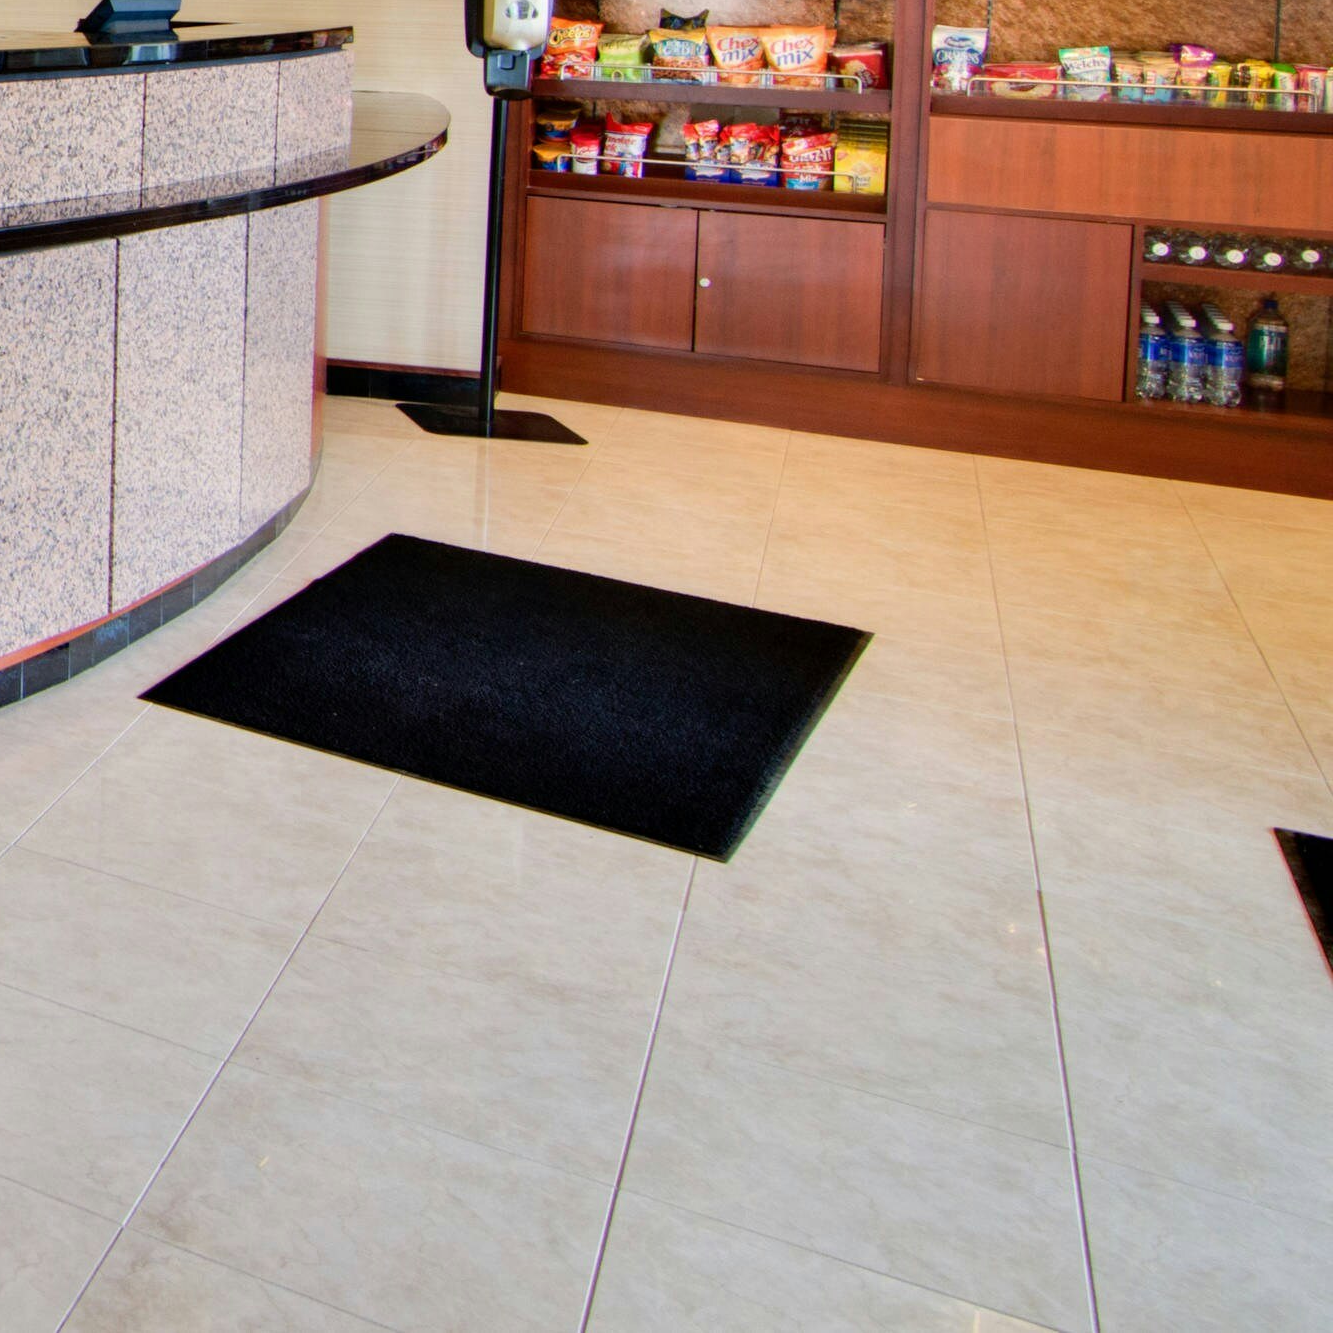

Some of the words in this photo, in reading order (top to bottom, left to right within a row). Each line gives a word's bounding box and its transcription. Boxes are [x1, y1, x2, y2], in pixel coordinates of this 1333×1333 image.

[549, 24, 595, 47] Cheetos
[716, 36, 760, 52] Chex
[769, 35, 815, 55] Chex
